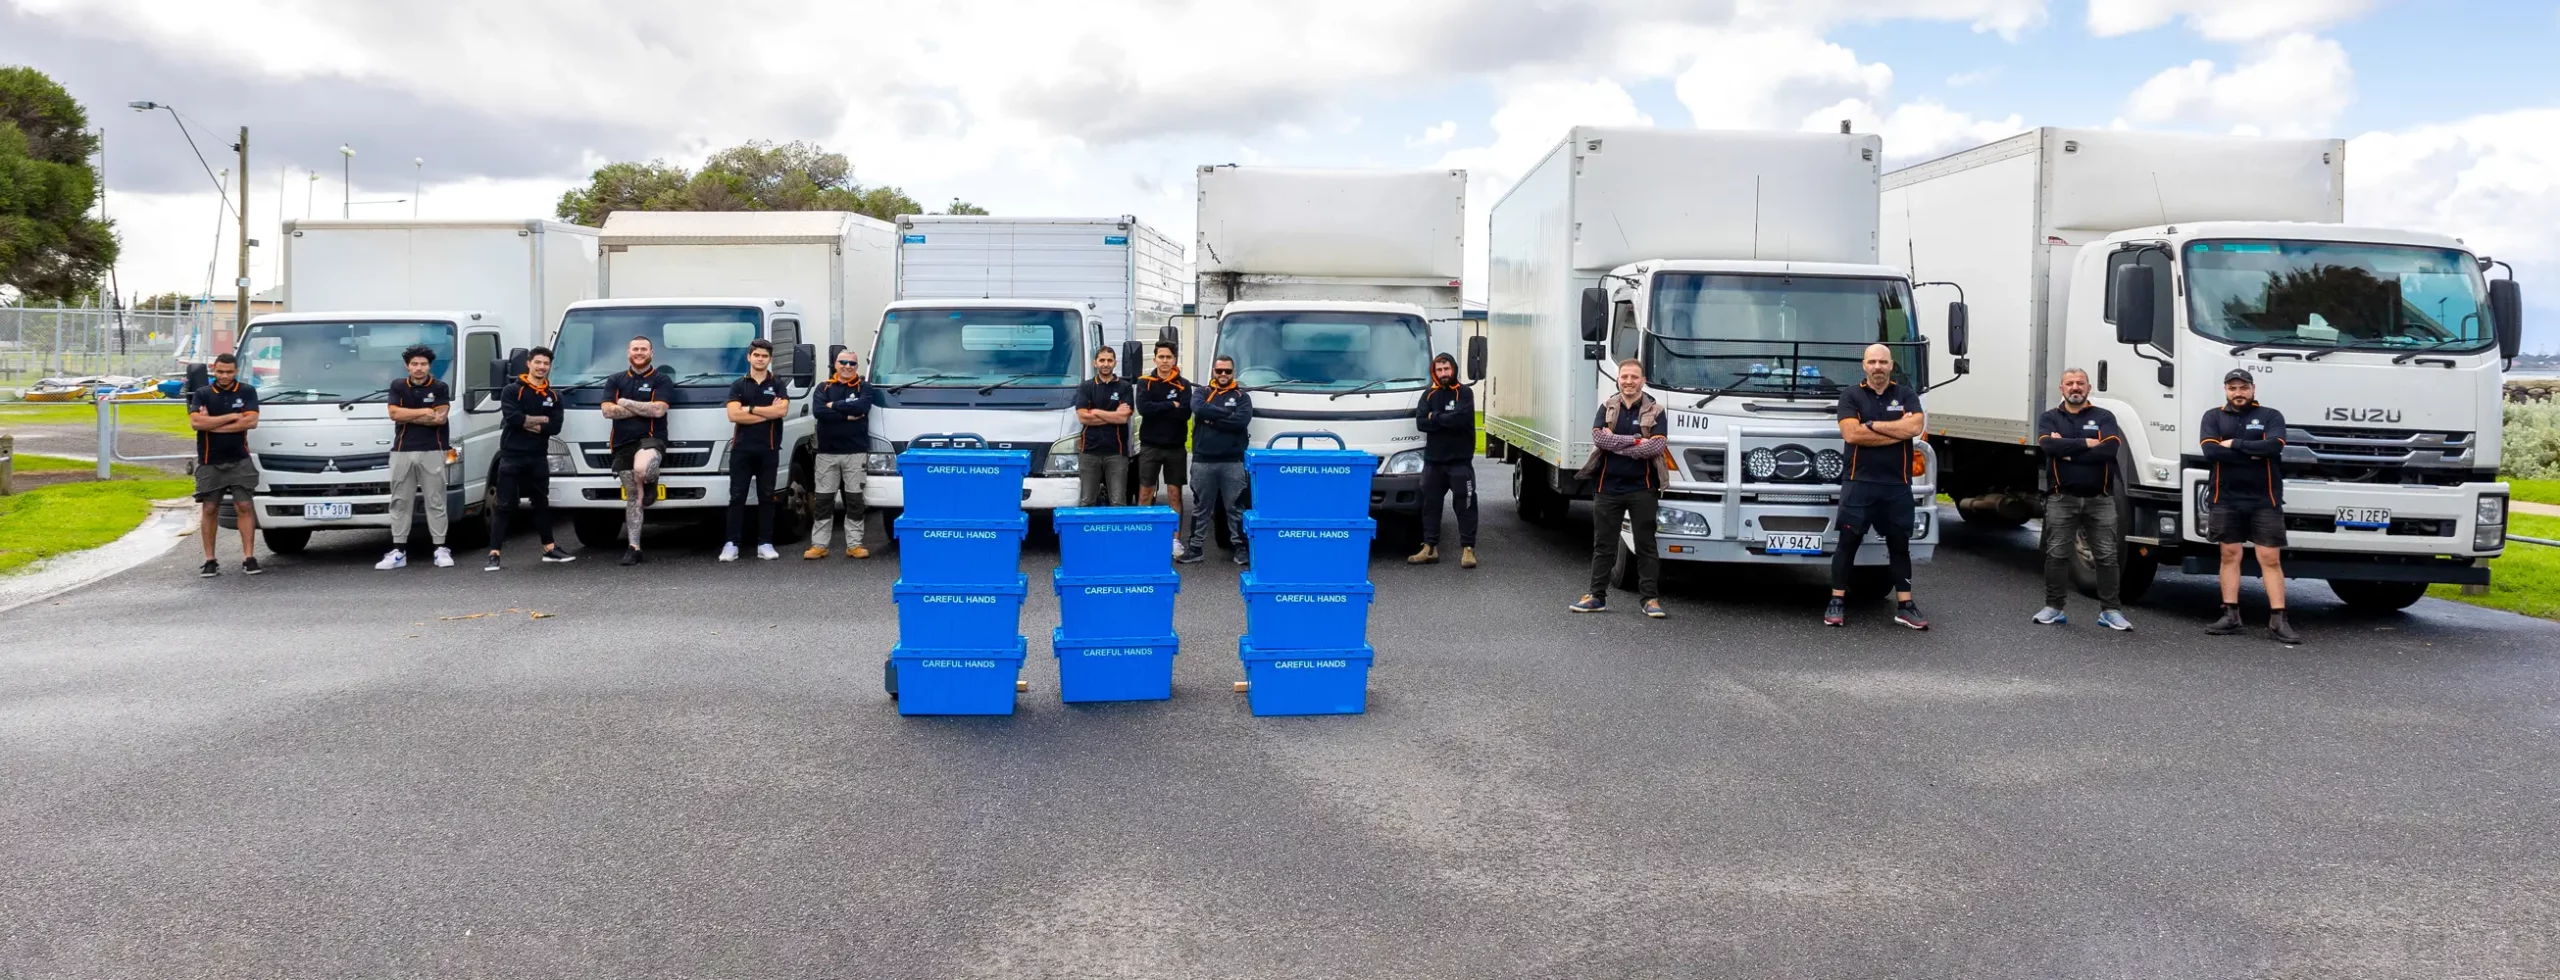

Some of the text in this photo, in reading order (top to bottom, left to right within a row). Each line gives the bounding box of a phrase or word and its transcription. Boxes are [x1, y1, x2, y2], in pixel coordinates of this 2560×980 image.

[2248, 364, 2273, 373] FVD
[2325, 407, 2401, 423] ISUZU
[1677, 414, 1709, 430] HINO
[926, 465, 1000, 474] CAREFUL HANDS
[1279, 465, 1351, 474] CAREFUL HANDS
[1083, 523, 1153, 532] CAREFUL HANDS
[923, 530, 997, 539] CAREFUL HANDS
[1278, 530, 1349, 539] CAREFUL HANDS
[1084, 585, 1154, 595] CAREFUL HANDS
[923, 595, 996, 604] CAREFUL HANDS
[1275, 595, 1347, 603] CAREFUL HANDS
[1083, 647, 1153, 657] CAREFUL HANDS
[922, 660, 995, 669] CAREFUL HANDS
[1275, 660, 1346, 669] CAREFUL HANDS
